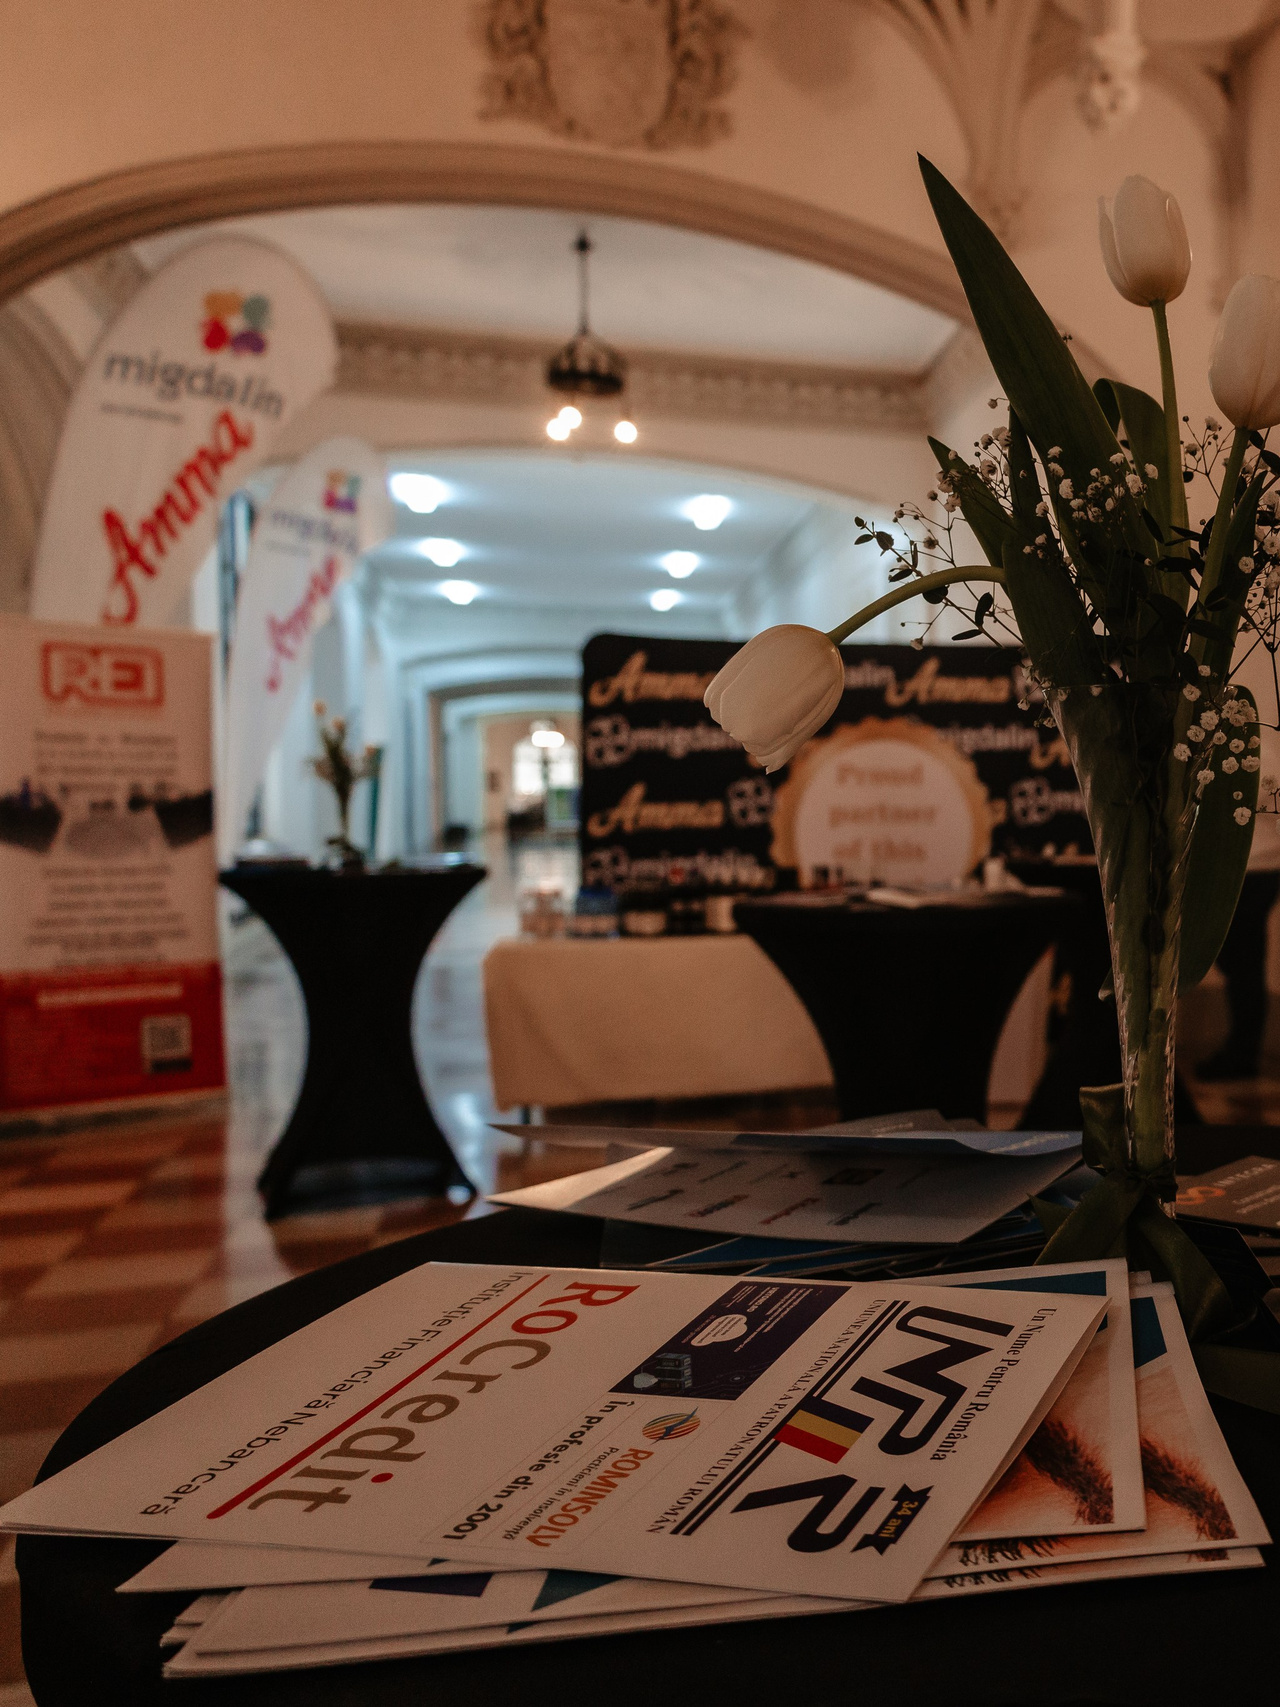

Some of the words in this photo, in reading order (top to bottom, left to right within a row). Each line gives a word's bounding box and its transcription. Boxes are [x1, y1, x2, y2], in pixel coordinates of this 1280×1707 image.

[587, 780, 725, 841] Amma
[1029, 1308, 1057, 1321] Un
[1003, 1324, 1046, 1355] Nume
[301, 1329, 445, 1409] Financiară
[972, 1358, 1021, 1398] Pentru
[242, 1281, 643, 1515] RoCredit
[597, 1399, 636, 1413] În
[526, 1415, 611, 1472] profesie
[693, 1402, 788, 1485] PATRONATULUI
[925, 1401, 992, 1461] România
[136, 1411, 319, 1516] Nebancară
[493, 1475, 541, 1499] din
[517, 1448, 657, 1547] ROMINSOLV
[643, 1487, 704, 1533] ROMÂN
[893, 1500, 919, 1516] 34
[440, 1502, 505, 1539] 2001
[875, 1518, 906, 1538] ani
